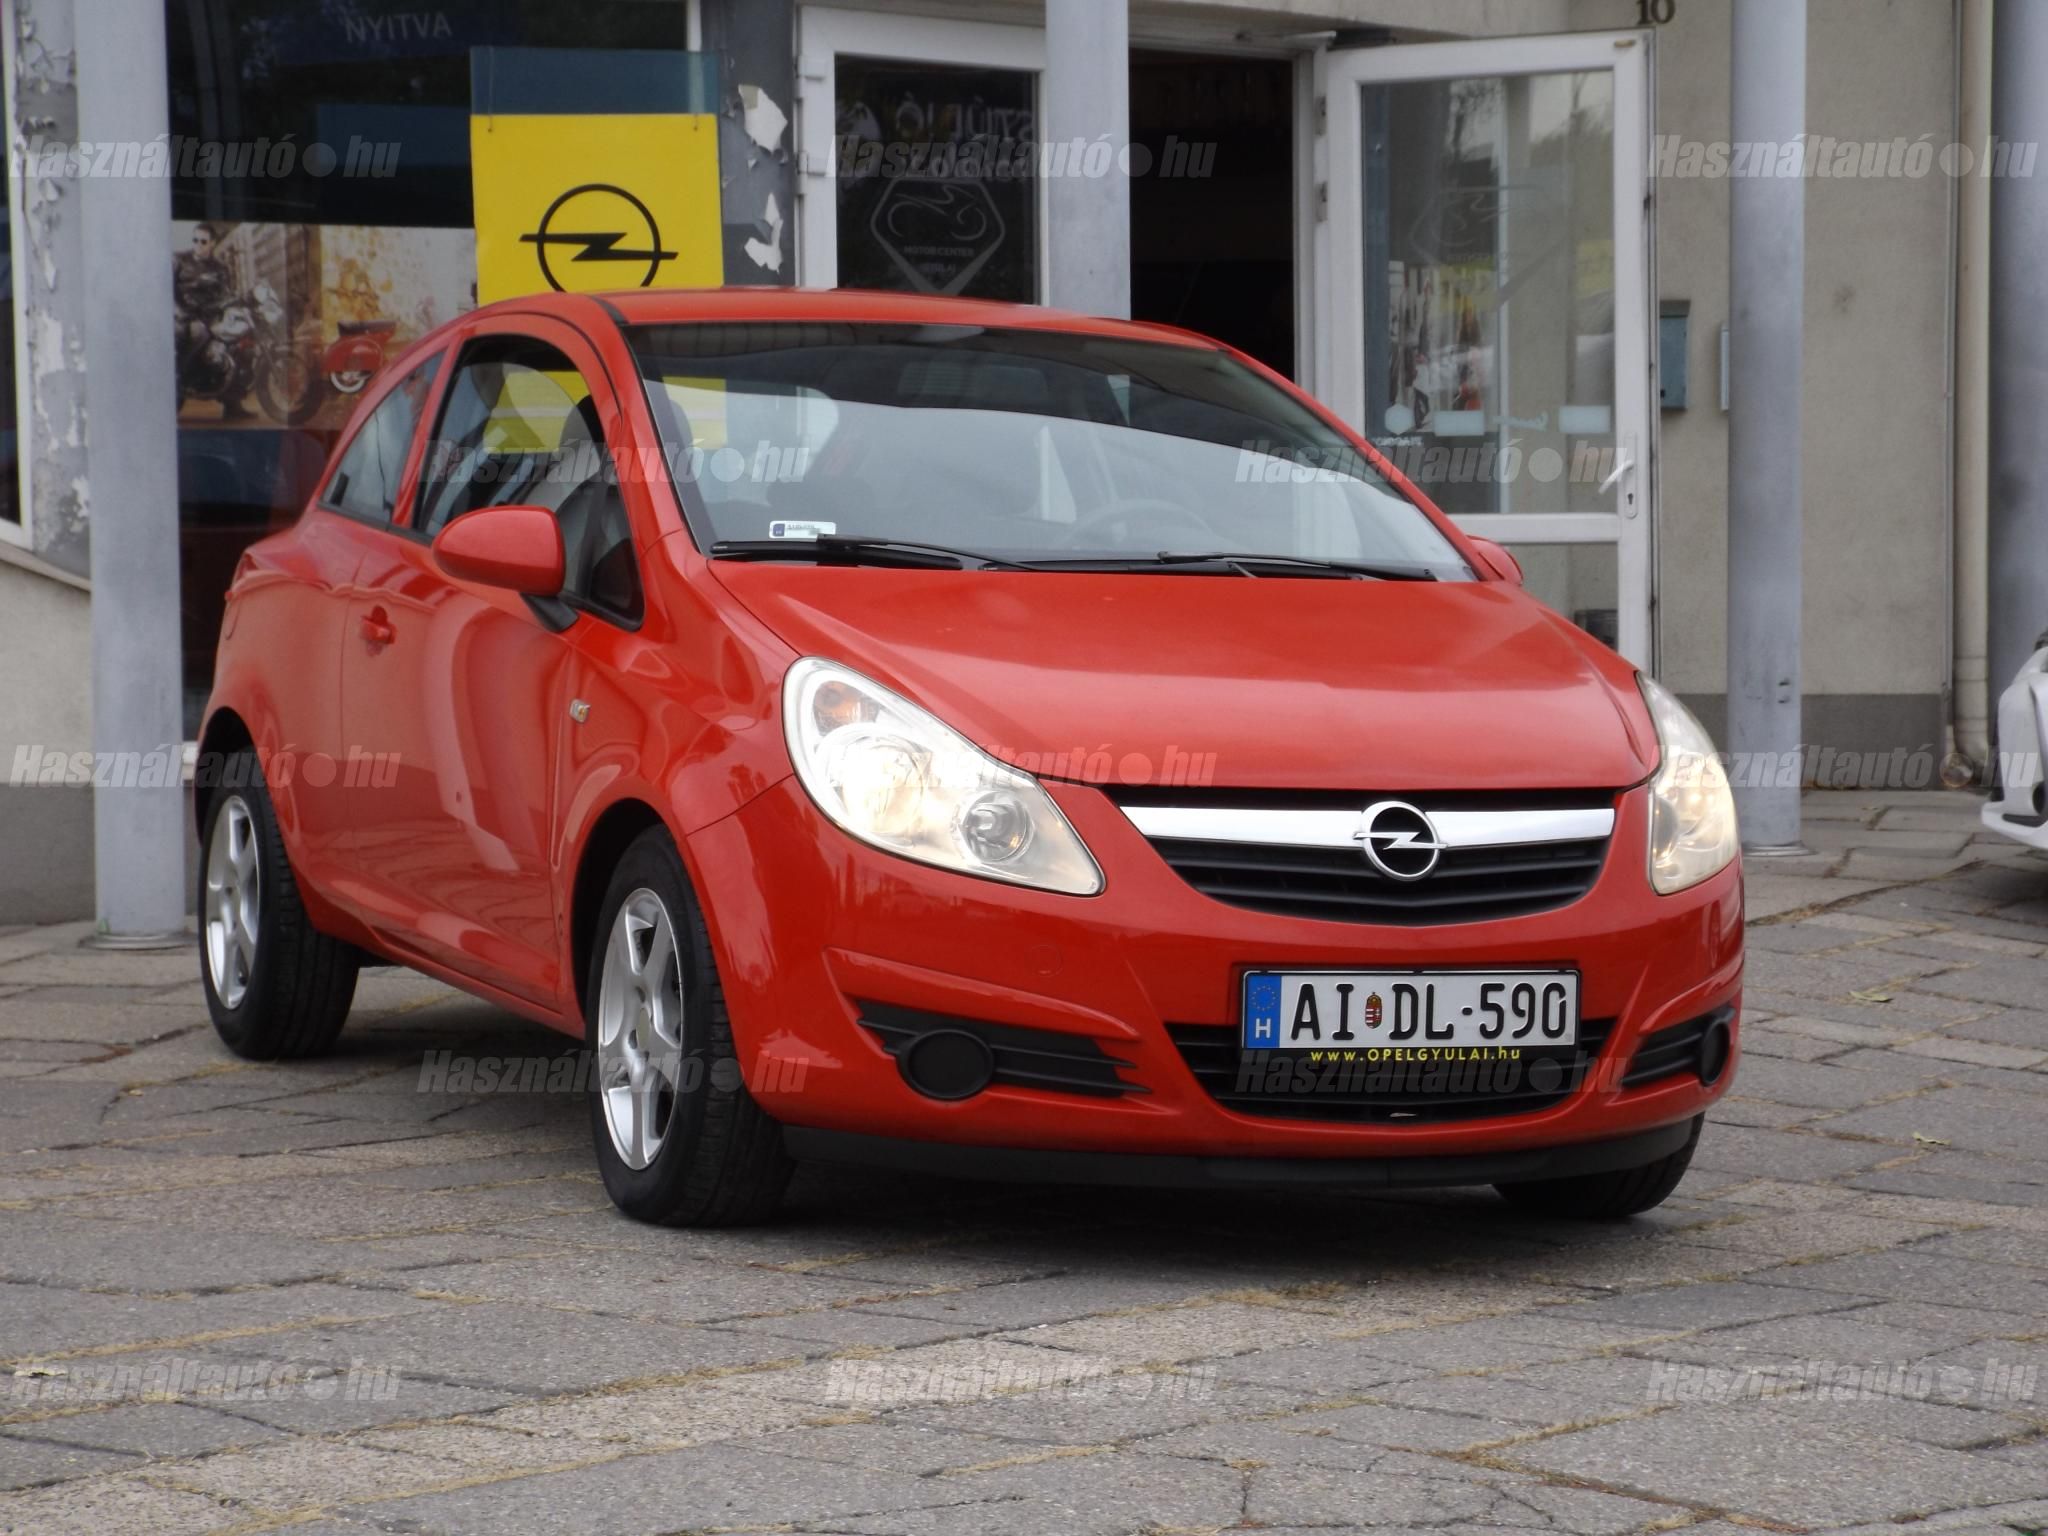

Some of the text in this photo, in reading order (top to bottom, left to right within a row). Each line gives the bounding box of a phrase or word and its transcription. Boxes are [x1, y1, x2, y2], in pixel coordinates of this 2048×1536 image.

[1636, 0, 1675, 25] 10
[345, 11, 452, 44] NYITVA
[1254, 1017, 1271, 1039] H
[1290, 983, 1354, 1041] AI
[1311, 1047, 1520, 1062] www.OPELGYULAI.hu
